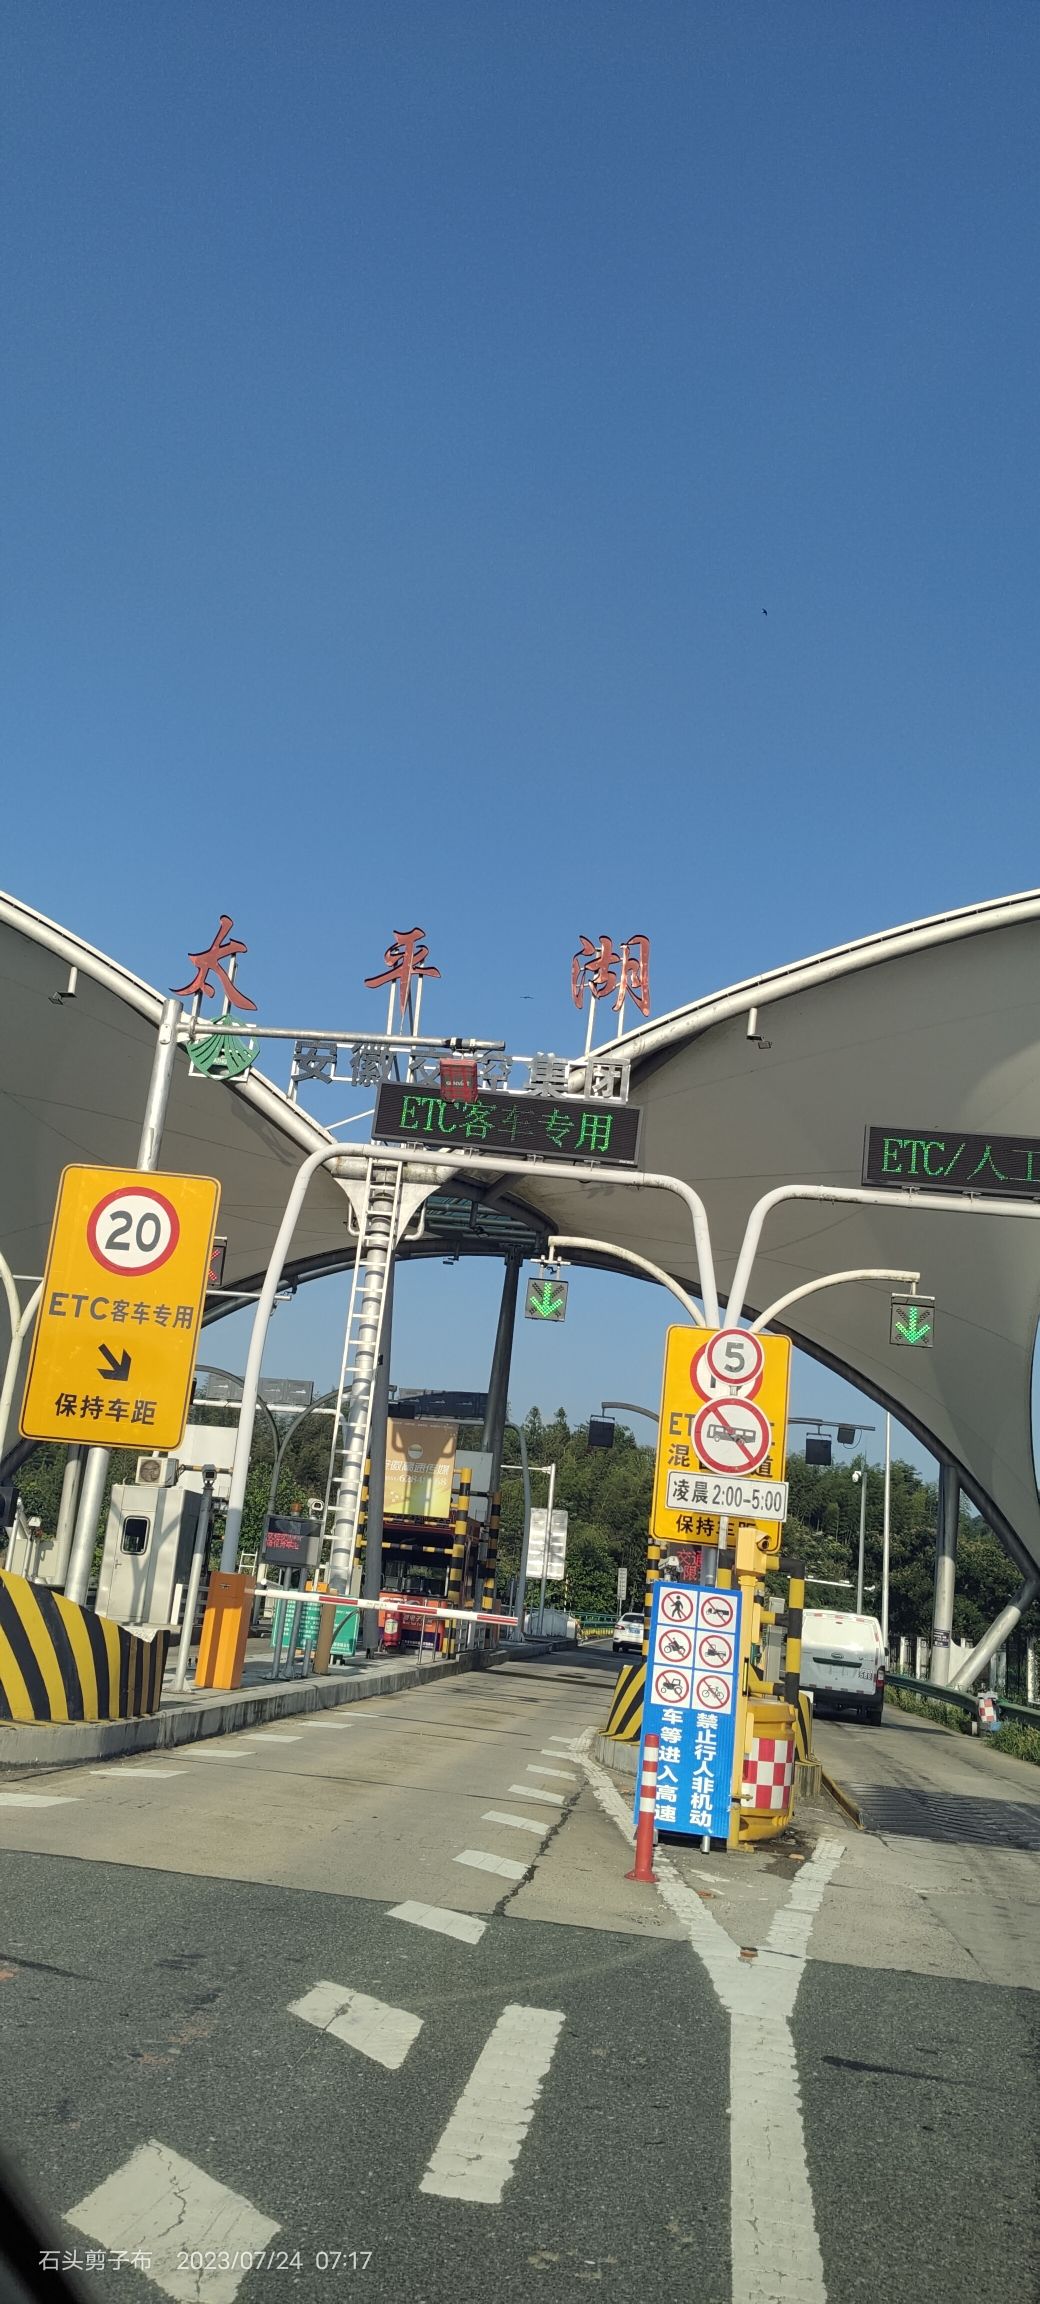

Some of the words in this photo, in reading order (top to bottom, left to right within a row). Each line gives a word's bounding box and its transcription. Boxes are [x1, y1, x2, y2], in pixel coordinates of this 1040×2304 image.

[169, 914, 650, 1019] 太平湖
[400, 1095, 614, 1152] ETC客车专用
[104, 1209, 162, 1253] 20
[48, 1292, 195, 1330] ETC客车专用
[723, 1341, 745, 1373] 5
[54, 1391, 158, 1426] 保持车距
[672, 1478, 782, 1512] 凌晨2:00-5:00
[654, 1708, 684, 1823] 车等进入高速
